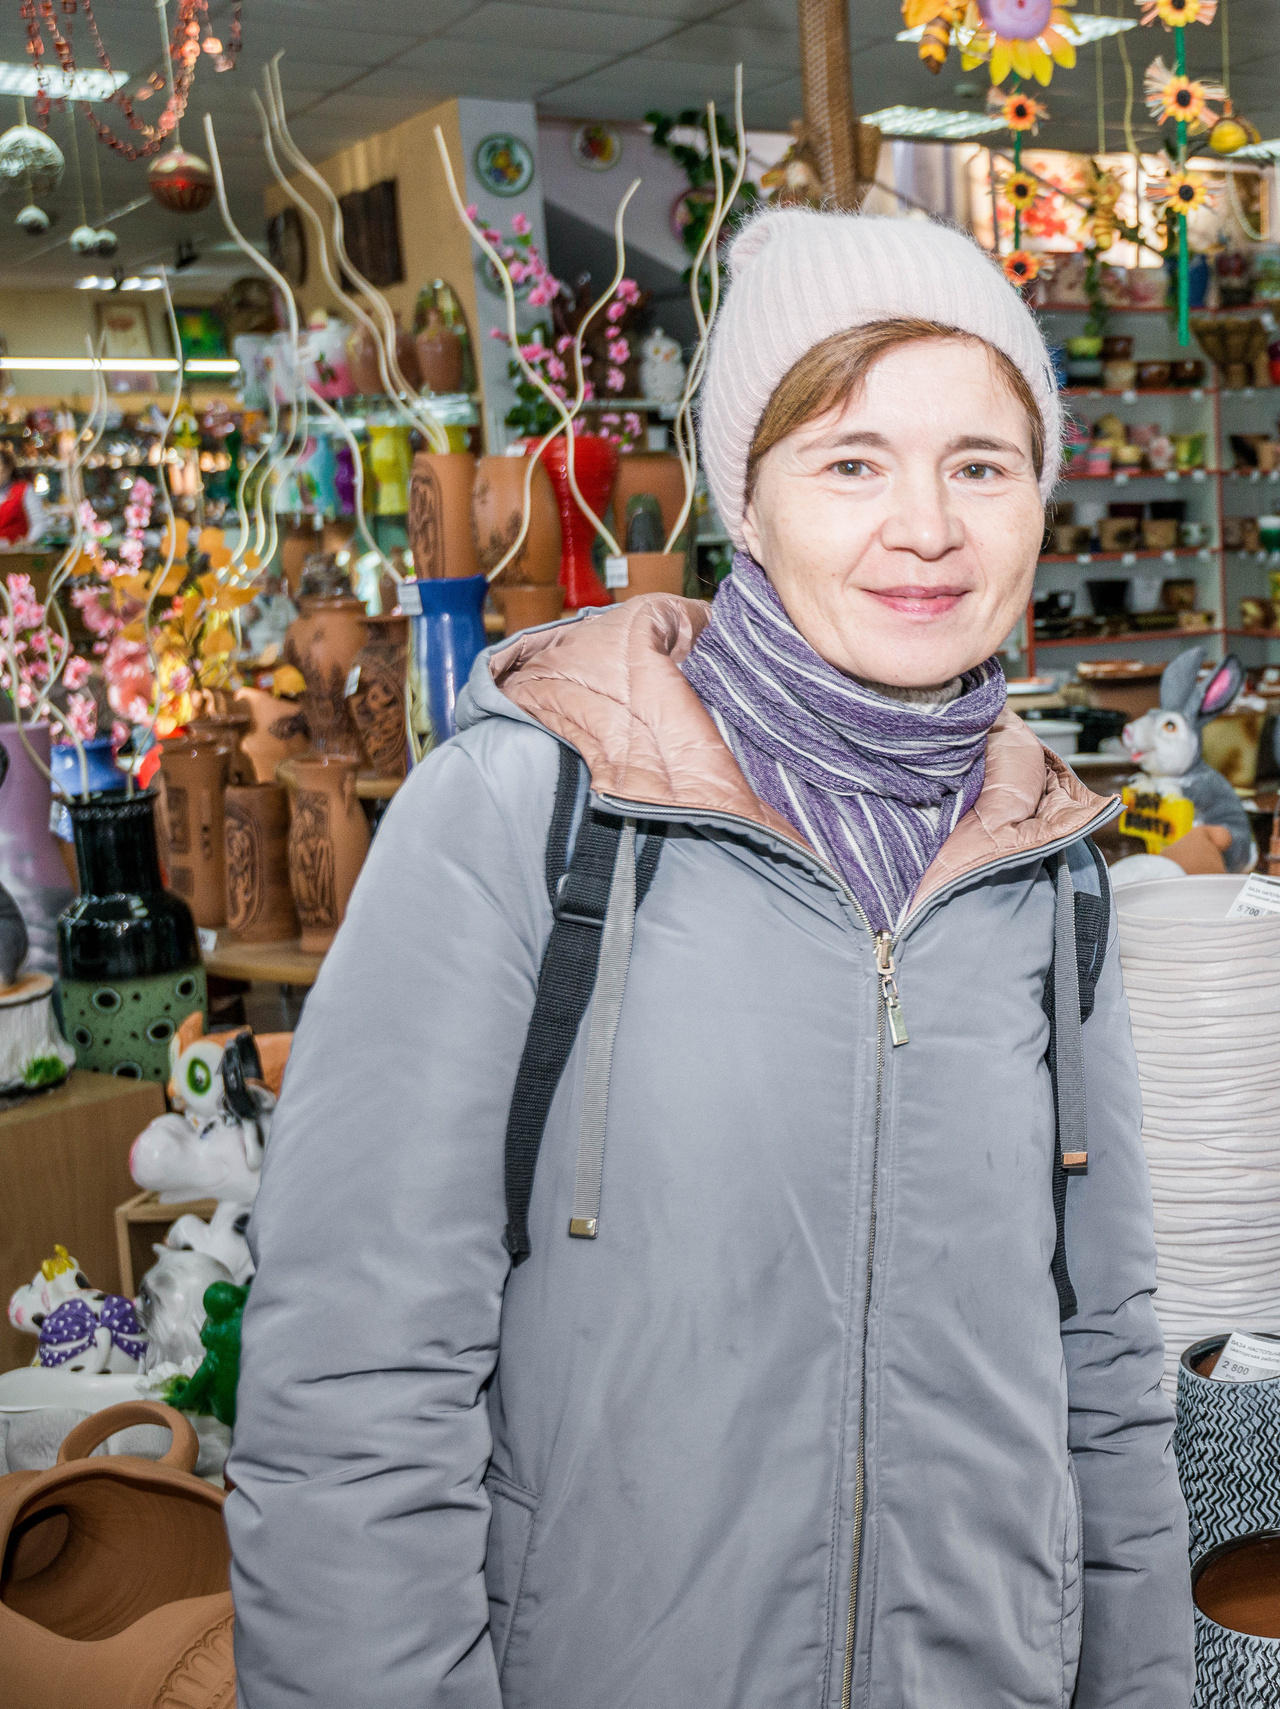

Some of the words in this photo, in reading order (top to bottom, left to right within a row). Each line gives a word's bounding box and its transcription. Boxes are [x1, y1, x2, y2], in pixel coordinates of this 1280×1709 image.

[1237, 904, 1244, 912] 5
[1244, 906, 1260, 917] 700
[1230, 1340, 1246, 1350] ВАЗА
[1222, 1360, 1230, 1369] 2
[1230, 1364, 1250, 1376] 800
